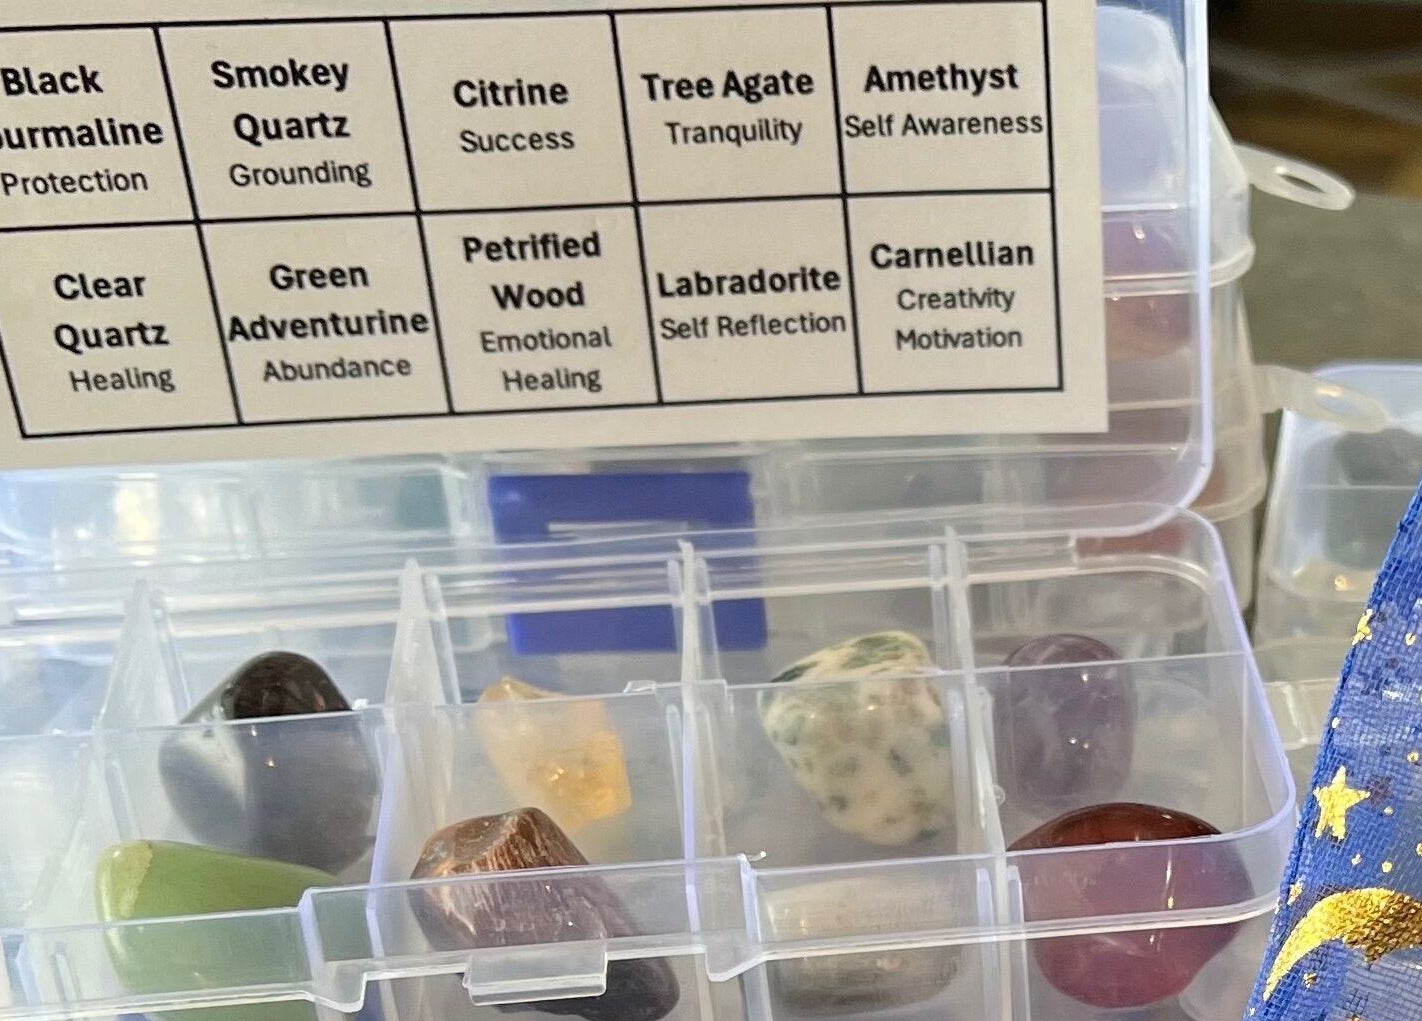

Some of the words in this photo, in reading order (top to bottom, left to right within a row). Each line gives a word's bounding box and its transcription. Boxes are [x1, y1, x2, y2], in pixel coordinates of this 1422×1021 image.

[0, 64, 104, 97] Black
[210, 57, 349, 93] Smokey
[639, 72, 715, 102] Tree
[721, 69, 814, 105] Agate
[863, 62, 1019, 97] Amethyst
[453, 77, 569, 108] Citrine
[0, 117, 164, 150] urmaline
[233, 112, 351, 145] Quartz
[664, 118, 803, 148] Tranquility
[844, 114, 894, 139] Self
[901, 113, 1044, 137] Awareness
[459, 129, 575, 154] Success
[0, 168, 149, 197] Protection
[229, 160, 373, 188] Grounding
[462, 230, 602, 263] Petrified
[870, 240, 1034, 270] Carnellian
[53, 272, 146, 301] Clear
[269, 263, 369, 291] Green
[656, 266, 841, 298] Labradorite
[490, 280, 586, 311] Wood
[897, 287, 1015, 313] Creativity
[53, 321, 170, 356] Quartz
[228, 309, 429, 342] Adventurine
[480, 325, 612, 353] Emotional
[660, 316, 709, 340] Self
[716, 311, 847, 337] Reflection
[895, 327, 1022, 351] Motivation
[69, 367, 176, 393] Healing
[263, 357, 411, 382] Abundance
[502, 368, 603, 393] Healing
